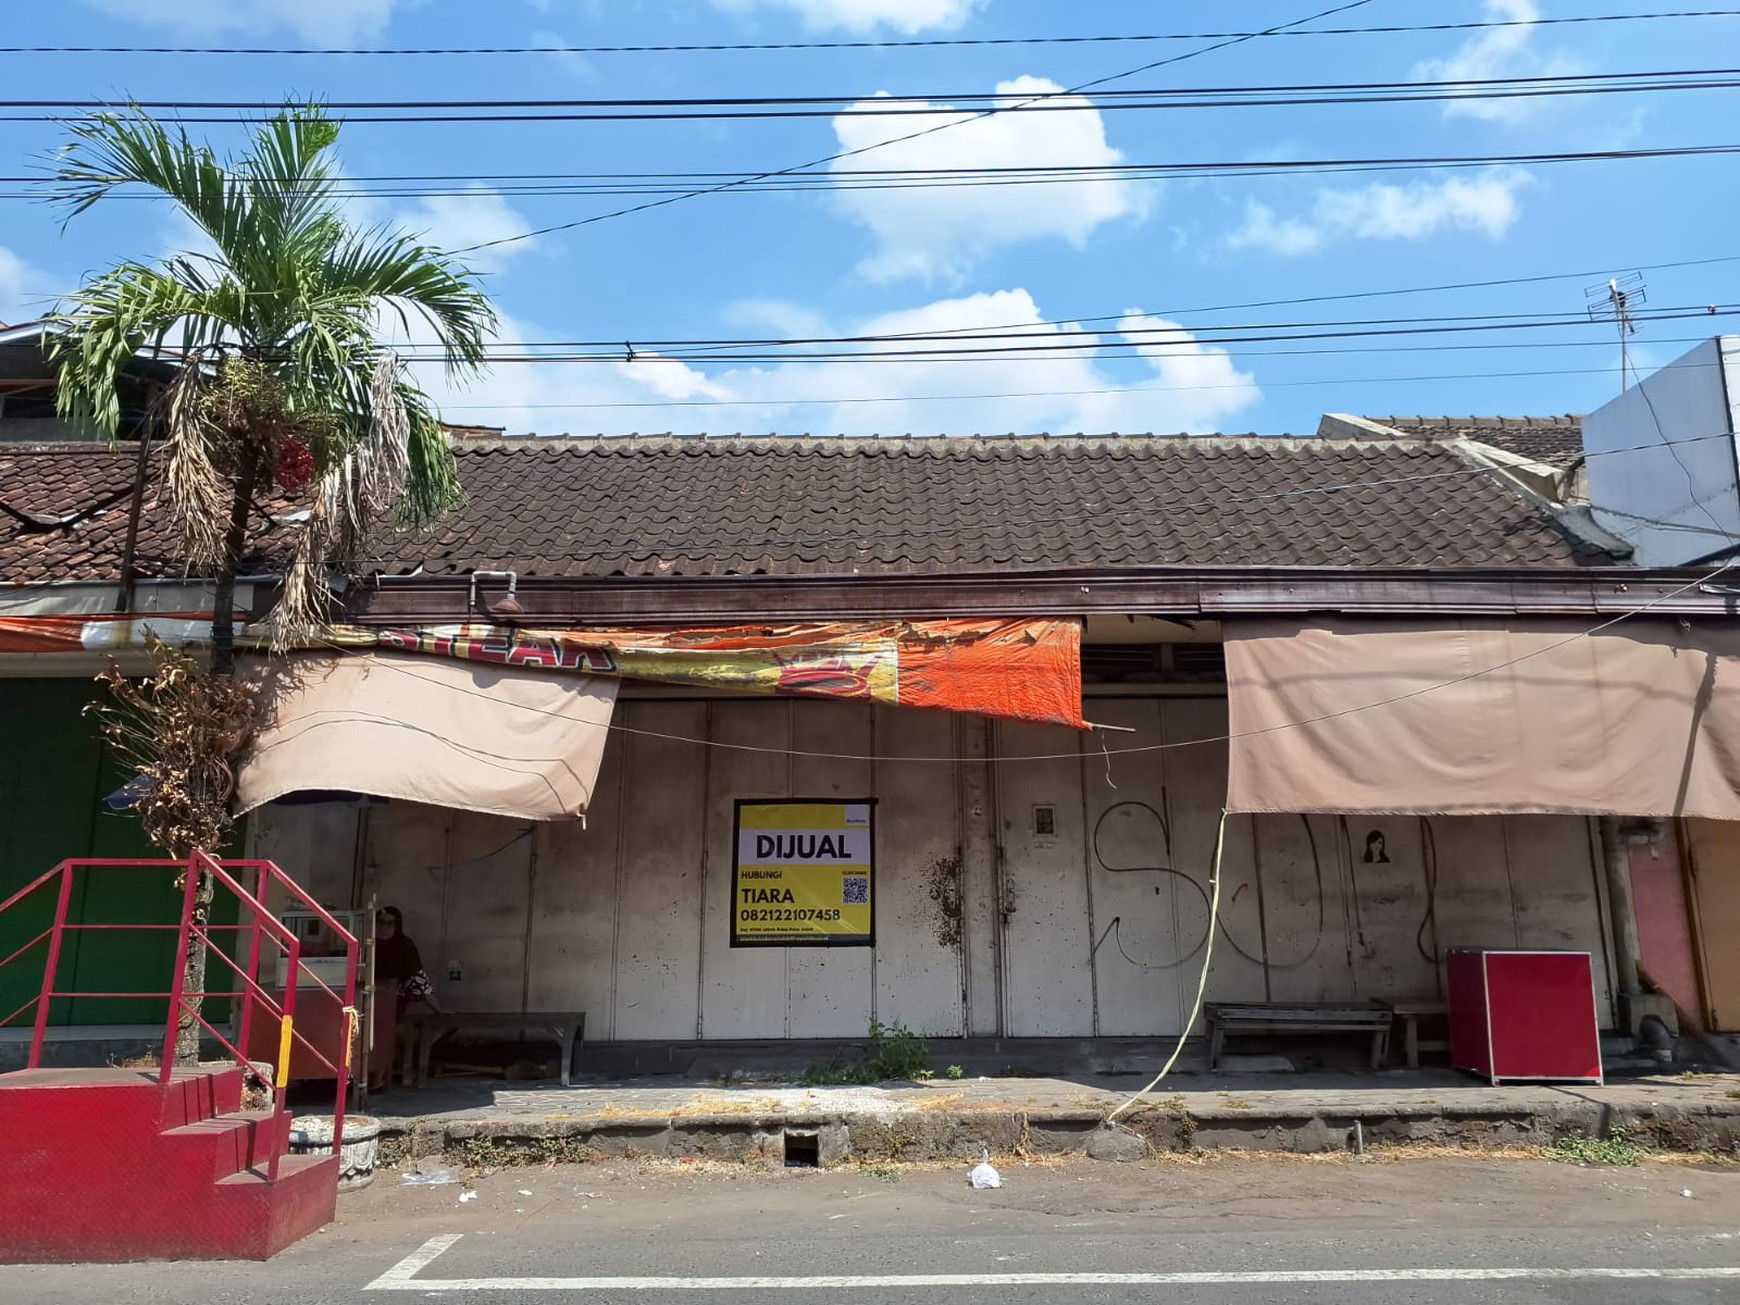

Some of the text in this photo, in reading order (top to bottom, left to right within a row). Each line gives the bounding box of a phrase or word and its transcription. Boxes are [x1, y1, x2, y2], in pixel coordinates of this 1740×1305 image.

[756, 834, 852, 859] DIJUAL
[740, 870, 782, 879] HUBUNGI
[741, 888, 795, 904] TIARA
[740, 908, 841, 921] 082122107458
